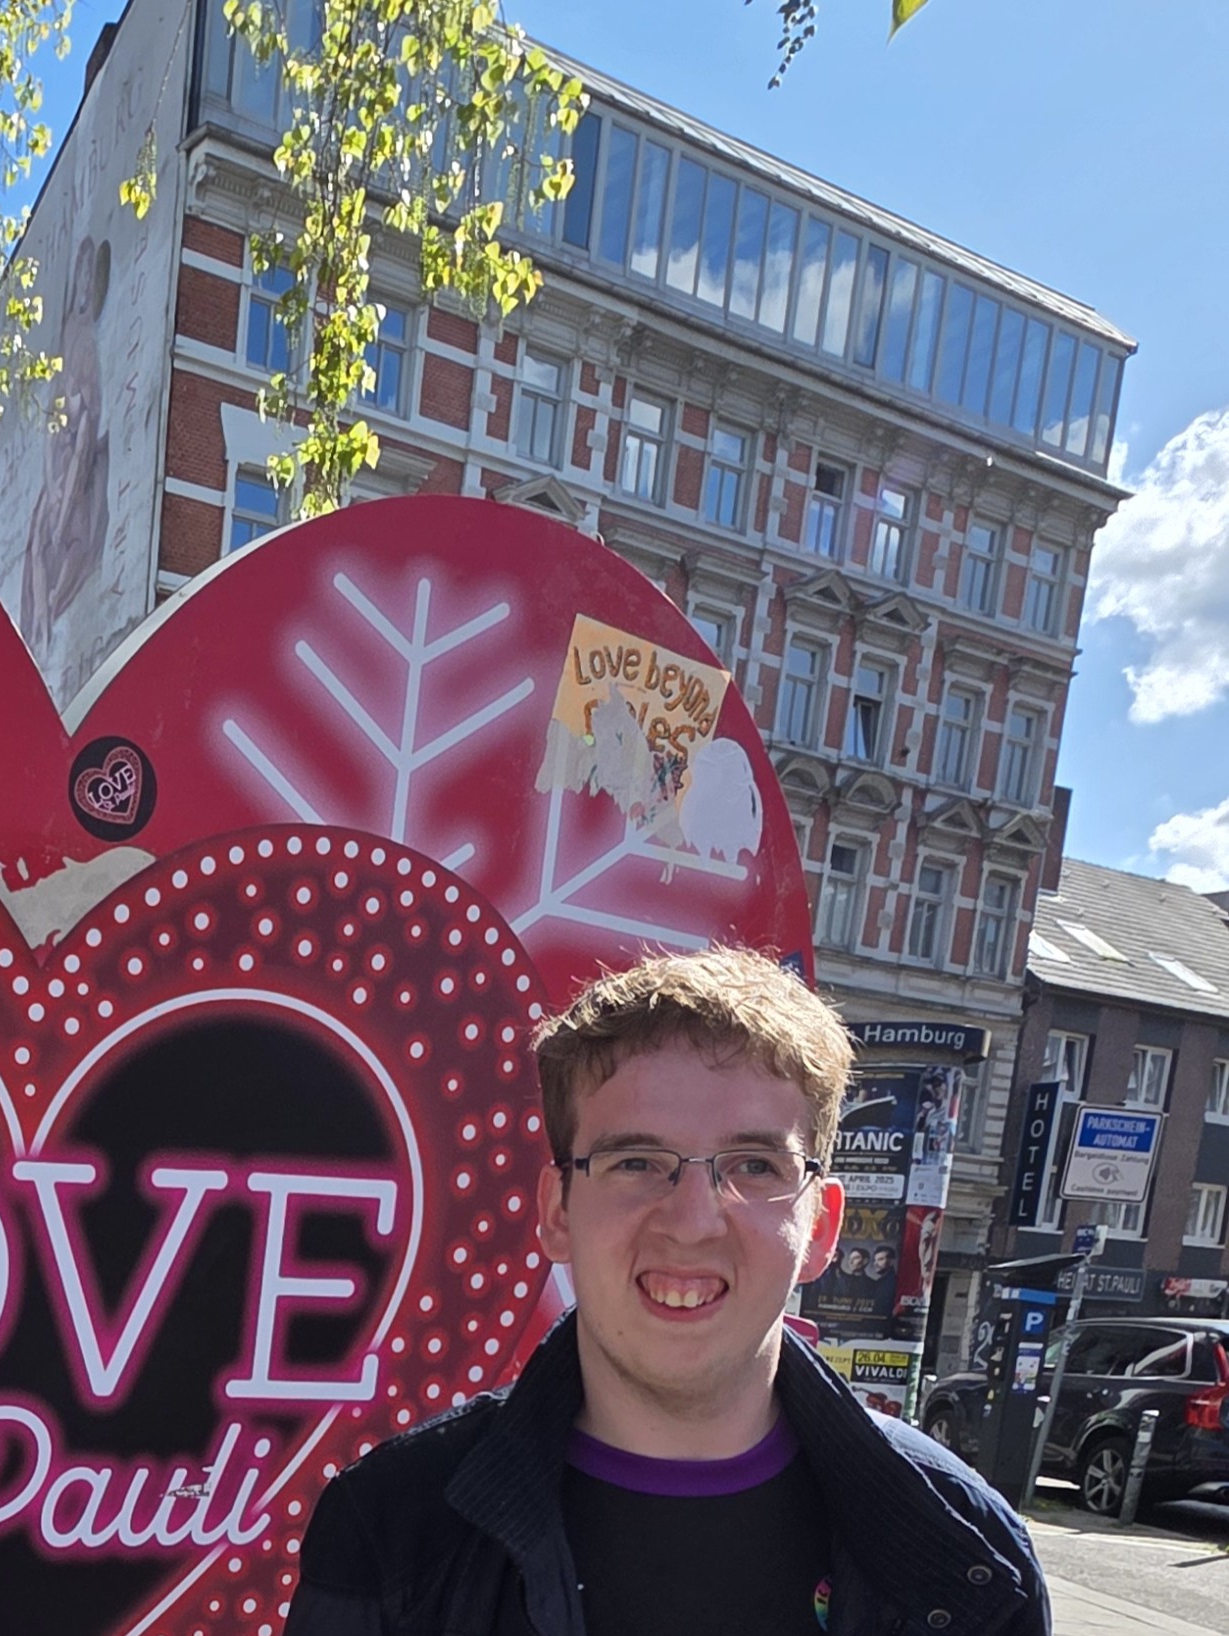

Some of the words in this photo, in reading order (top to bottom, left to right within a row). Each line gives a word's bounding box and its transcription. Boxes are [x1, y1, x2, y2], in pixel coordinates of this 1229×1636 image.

[574, 645, 642, 686] Love
[644, 650, 718, 738] beyond
[88, 764, 137, 808] LOVE
[864, 1024, 966, 1050] Hamburg
[1086, 1115, 1151, 1133] PARKSCHEIN-
[1092, 1133, 1139, 1149] AUTOMAT
[1018, 1091, 1050, 1217] HOTEL
[1121, 1153, 1149, 1165] Zahlung
[1057, 1271, 1096, 1291] HEIAT
[1025, 1312, 1044, 1332] P
[855, 1365, 907, 1379] VIVALDI
